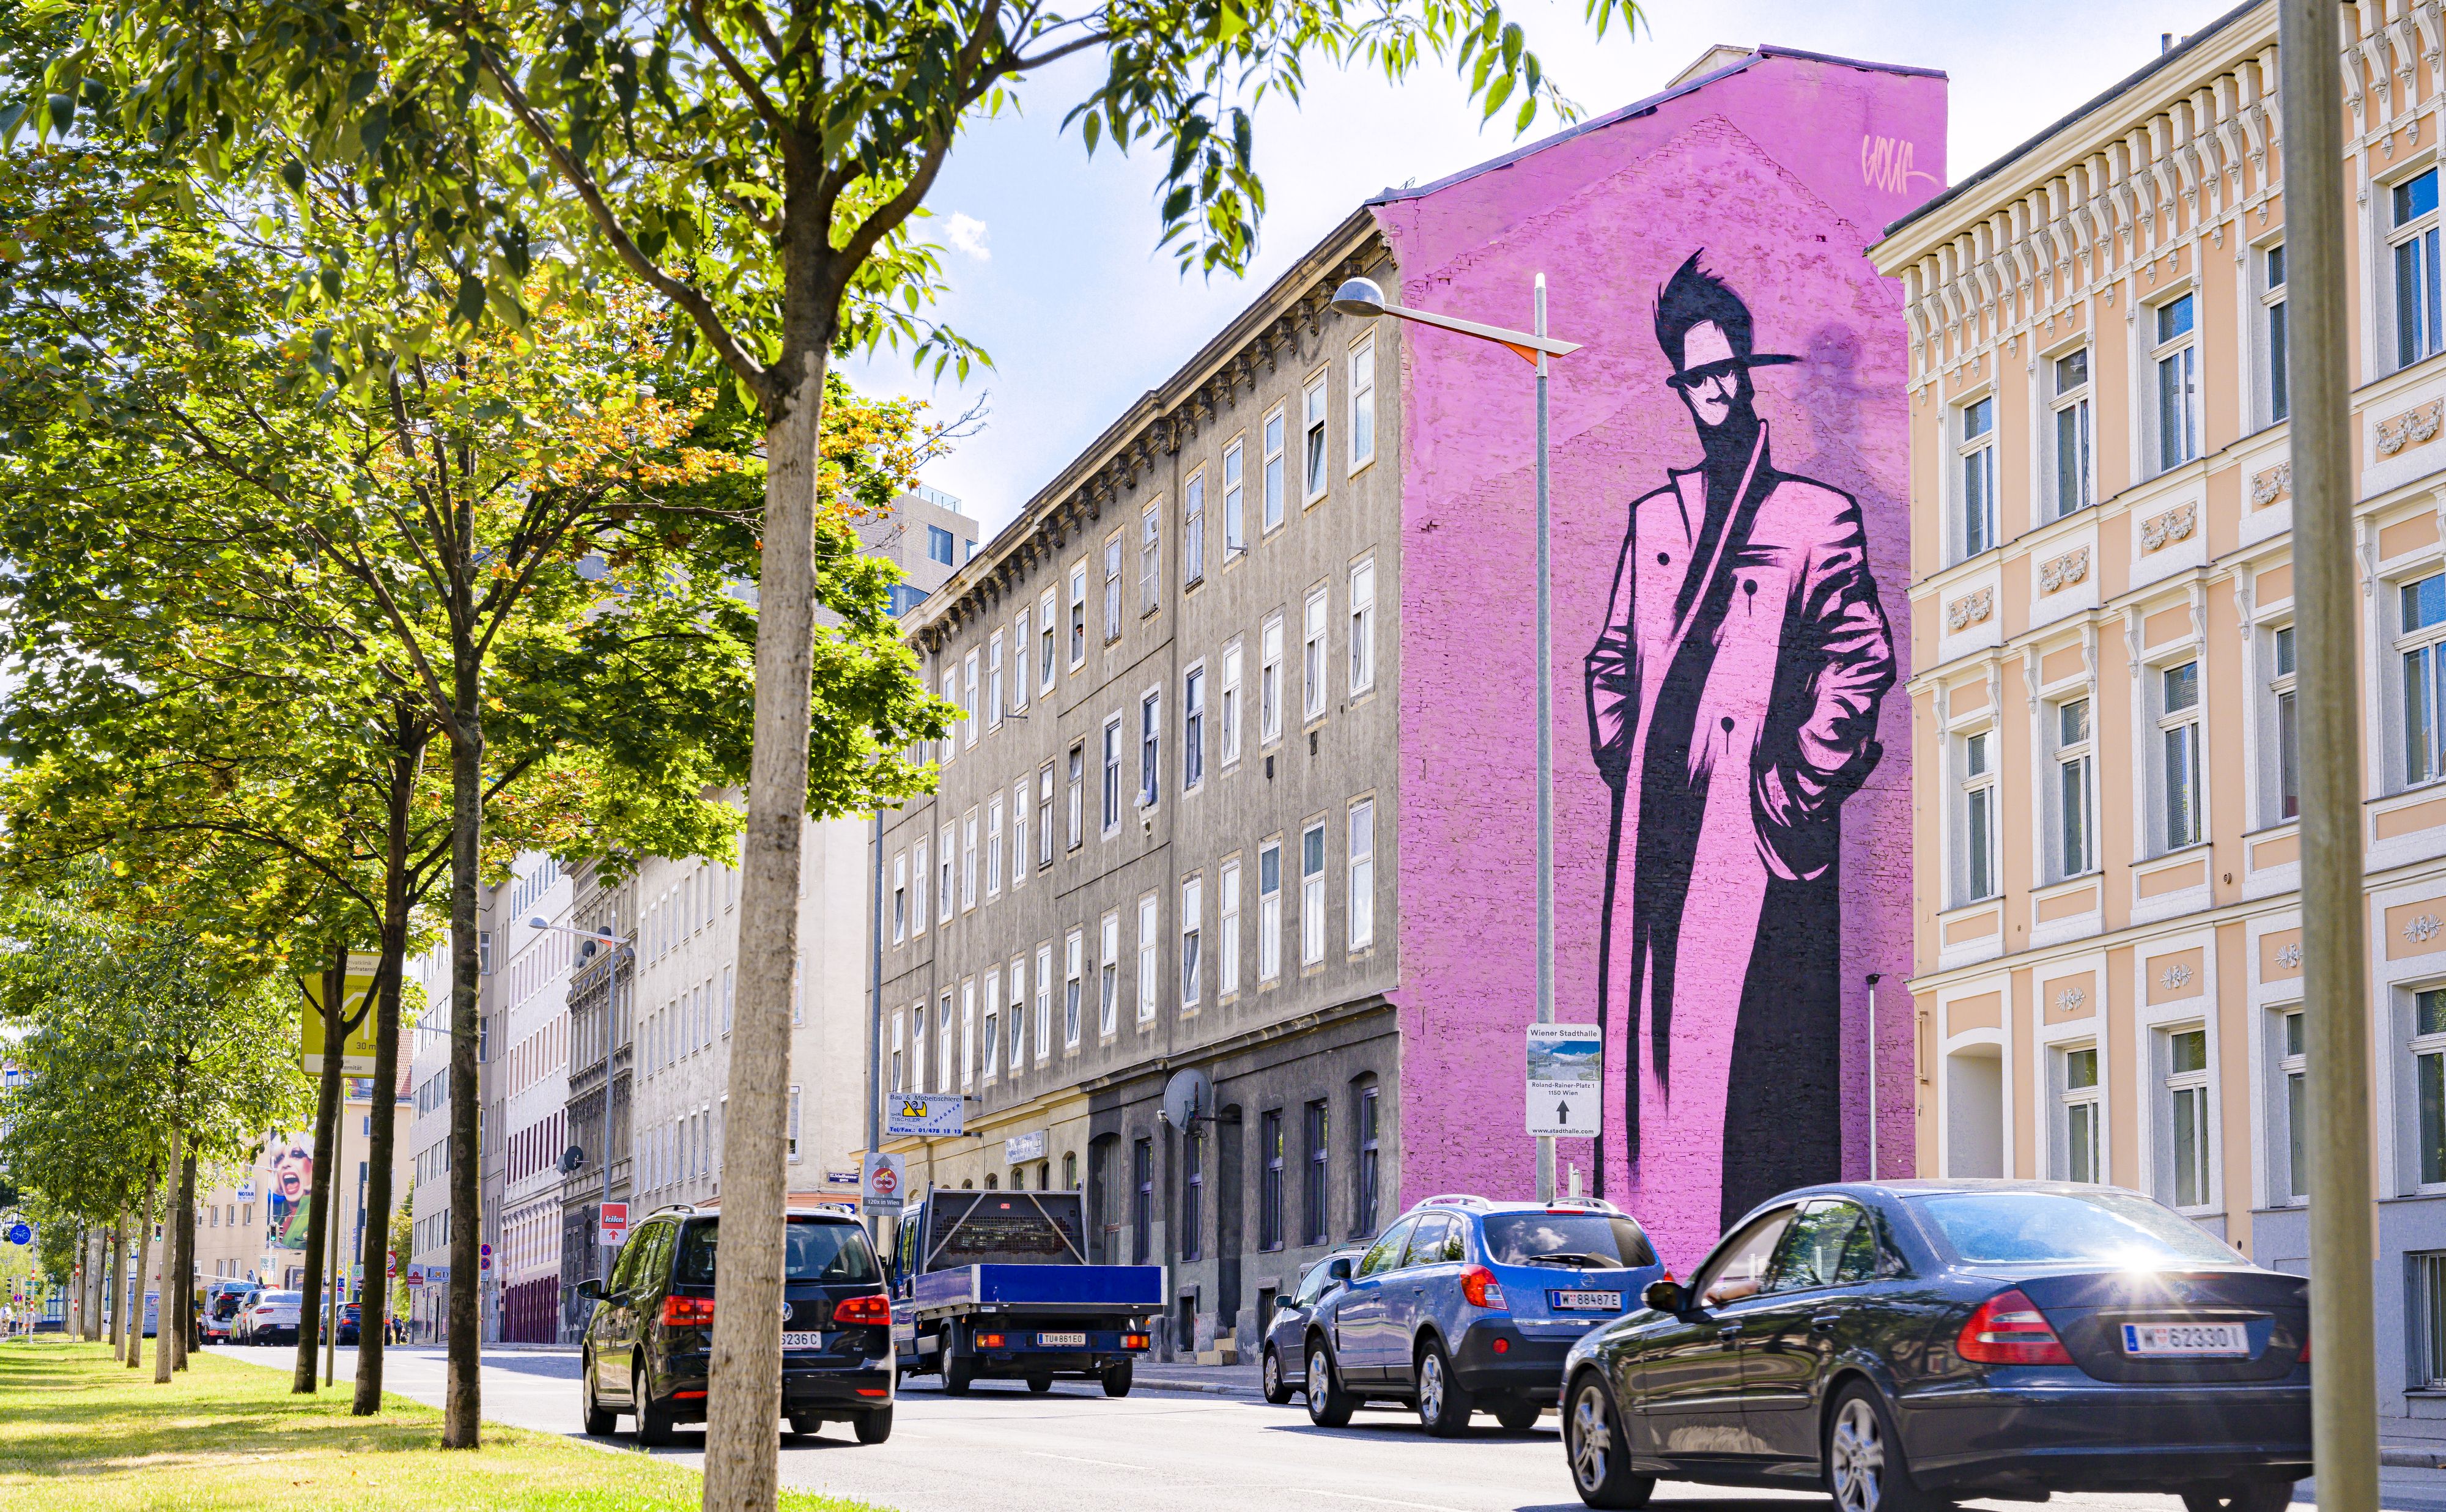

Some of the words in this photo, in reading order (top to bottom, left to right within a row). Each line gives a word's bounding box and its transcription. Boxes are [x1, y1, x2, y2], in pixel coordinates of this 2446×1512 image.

[934, 1104, 960, 1123] WAGNER
[1562, 1294, 1569, 1304] W
[1578, 1294, 1609, 1305] 88487
[1613, 1295, 1617, 1305] E
[781, 1334, 808, 1344] 6236
[811, 1334, 817, 1344] C
